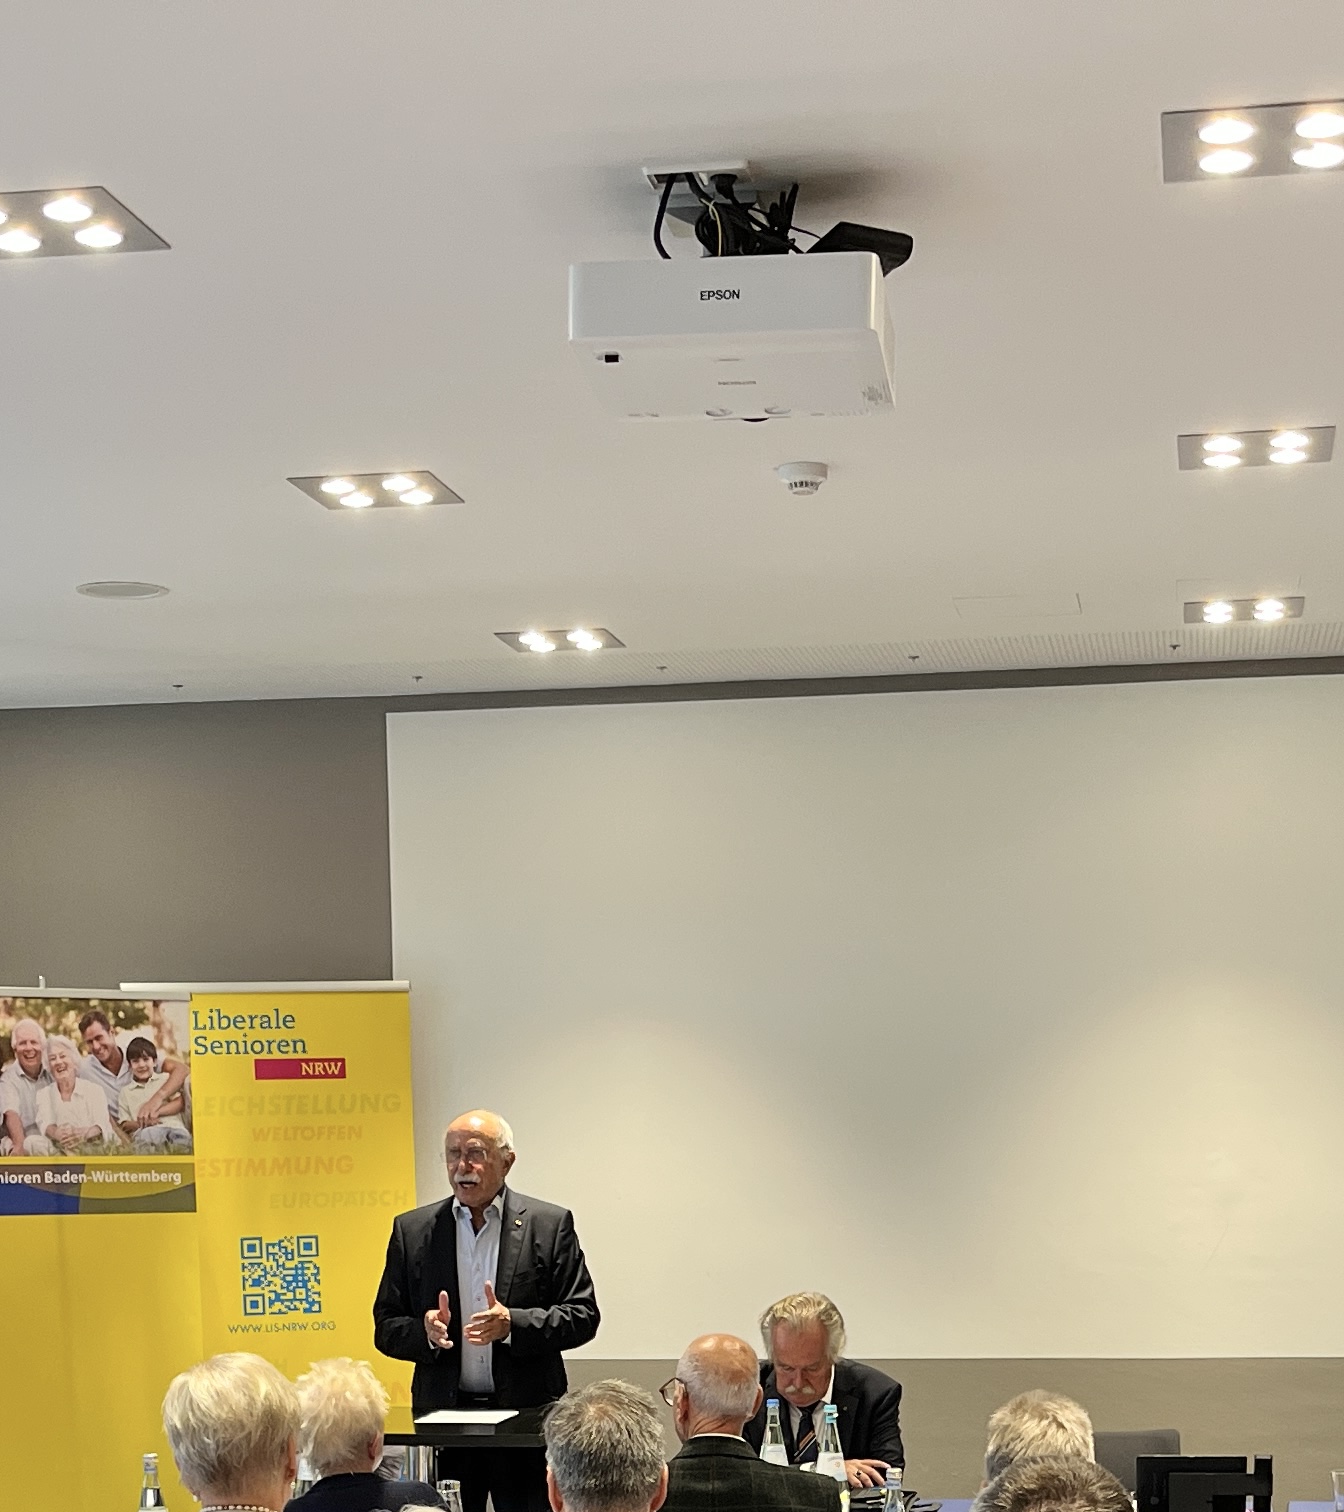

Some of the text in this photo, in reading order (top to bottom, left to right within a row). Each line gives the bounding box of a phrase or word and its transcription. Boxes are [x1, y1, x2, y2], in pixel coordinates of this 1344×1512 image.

[700, 289, 741, 301] EPSON
[192, 1008, 296, 1032] Liberale
[193, 1032, 308, 1056] Senioren
[300, 1060, 343, 1077] NRW
[252, 1125, 363, 1142] WELTOFFEN
[196, 1154, 355, 1179] ESTIMMUNG
[44, 1169, 182, 1187] Baden-Württemberg
